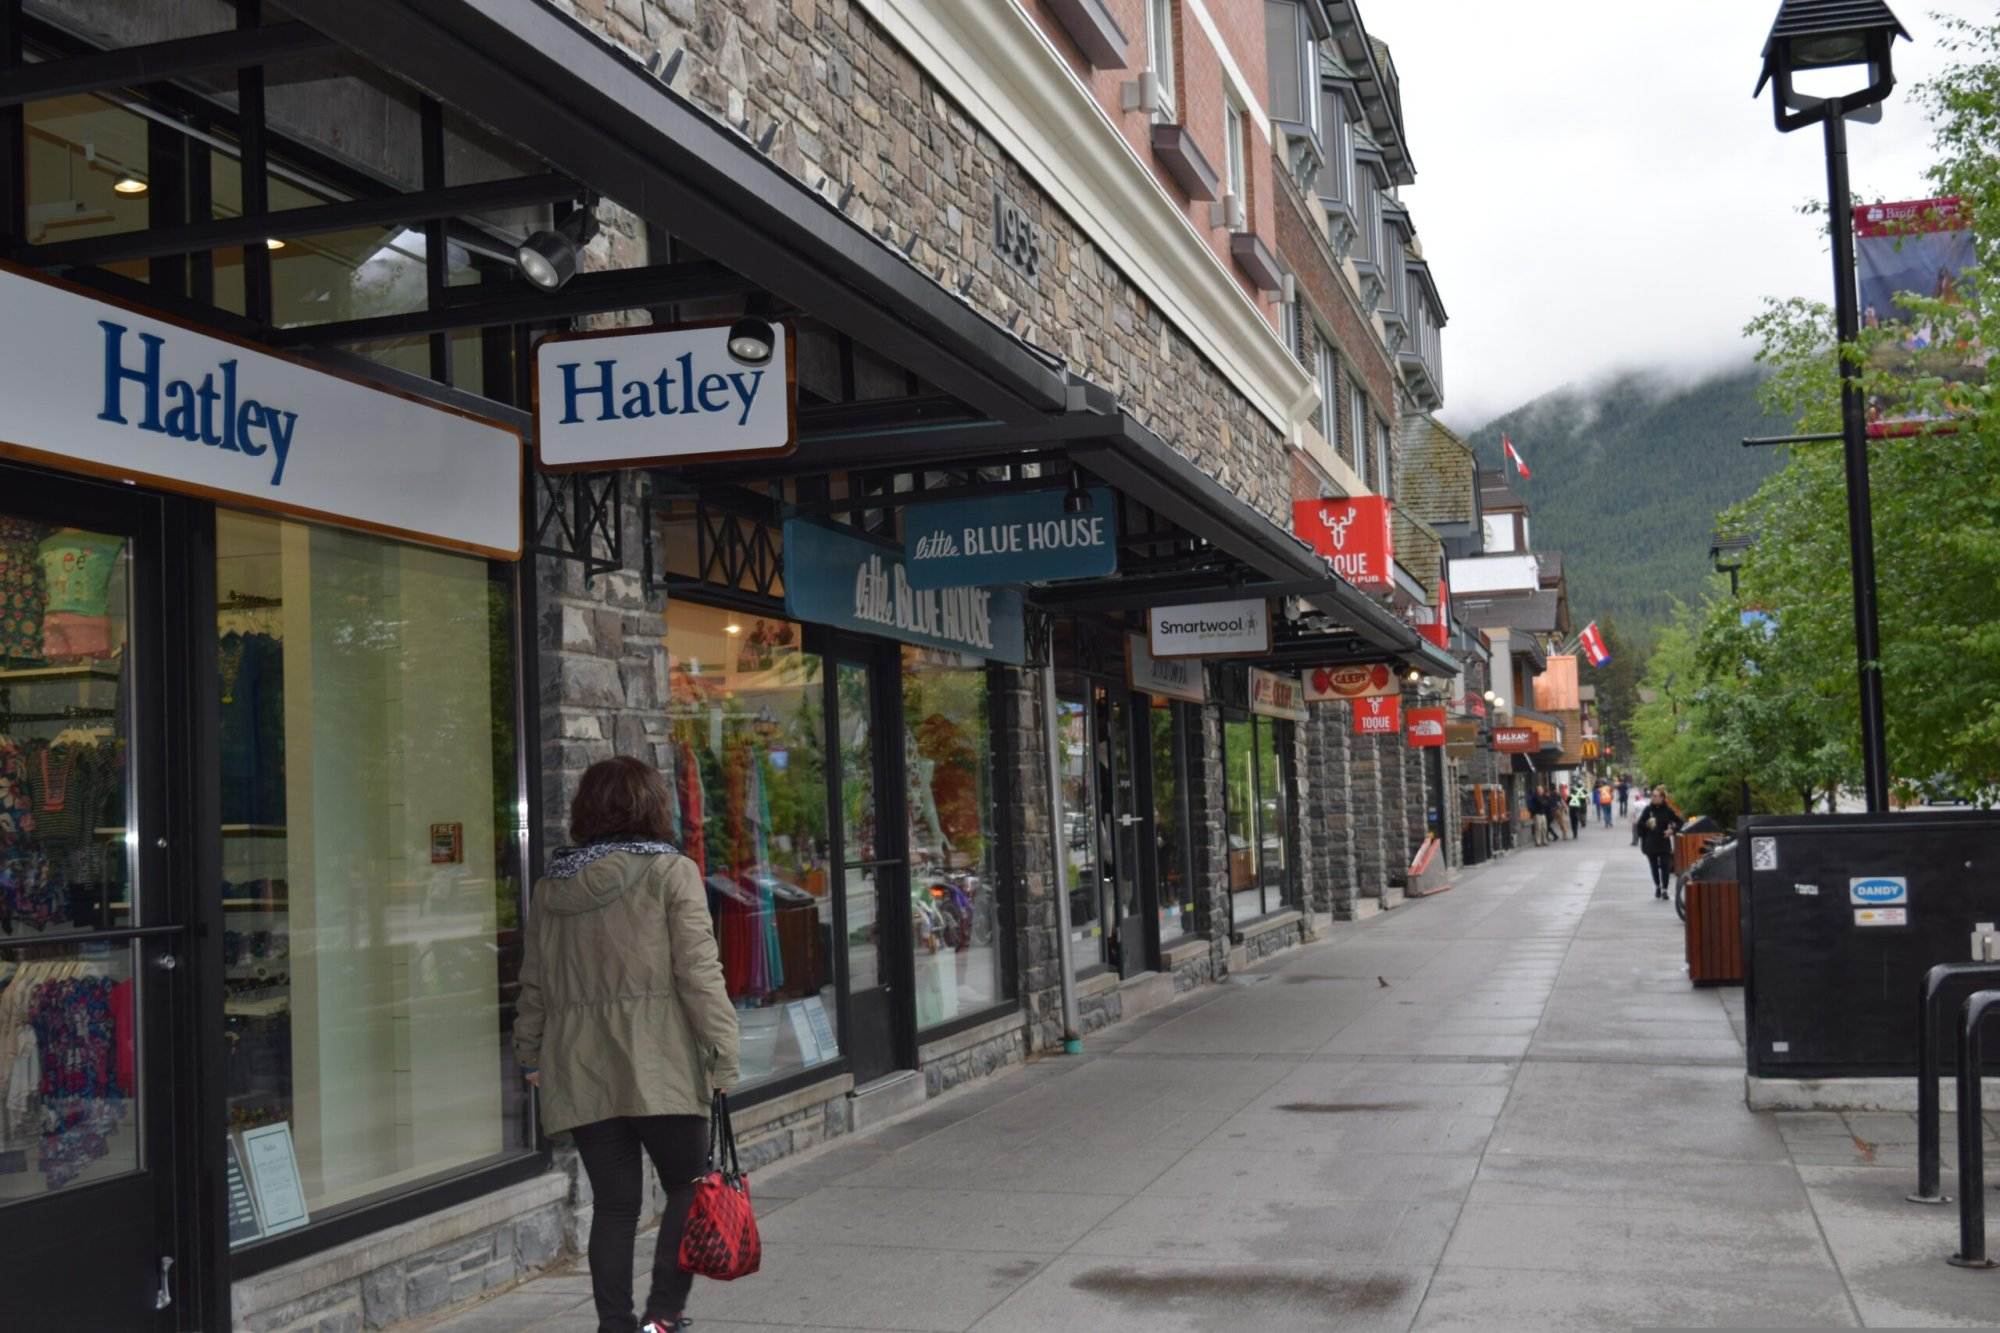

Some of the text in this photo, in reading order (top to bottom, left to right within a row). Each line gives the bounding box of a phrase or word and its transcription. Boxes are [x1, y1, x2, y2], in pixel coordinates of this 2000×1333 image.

[994, 193, 1039, 276] 1955
[97, 320, 298, 486] Hatley
[558, 351, 766, 426] Hatley
[913, 516, 1105, 560] little BLUE HOUSE
[854, 553, 896, 626] little
[943, 586, 994, 650] HOUSE
[1160, 617, 1242, 635] Smartwool
